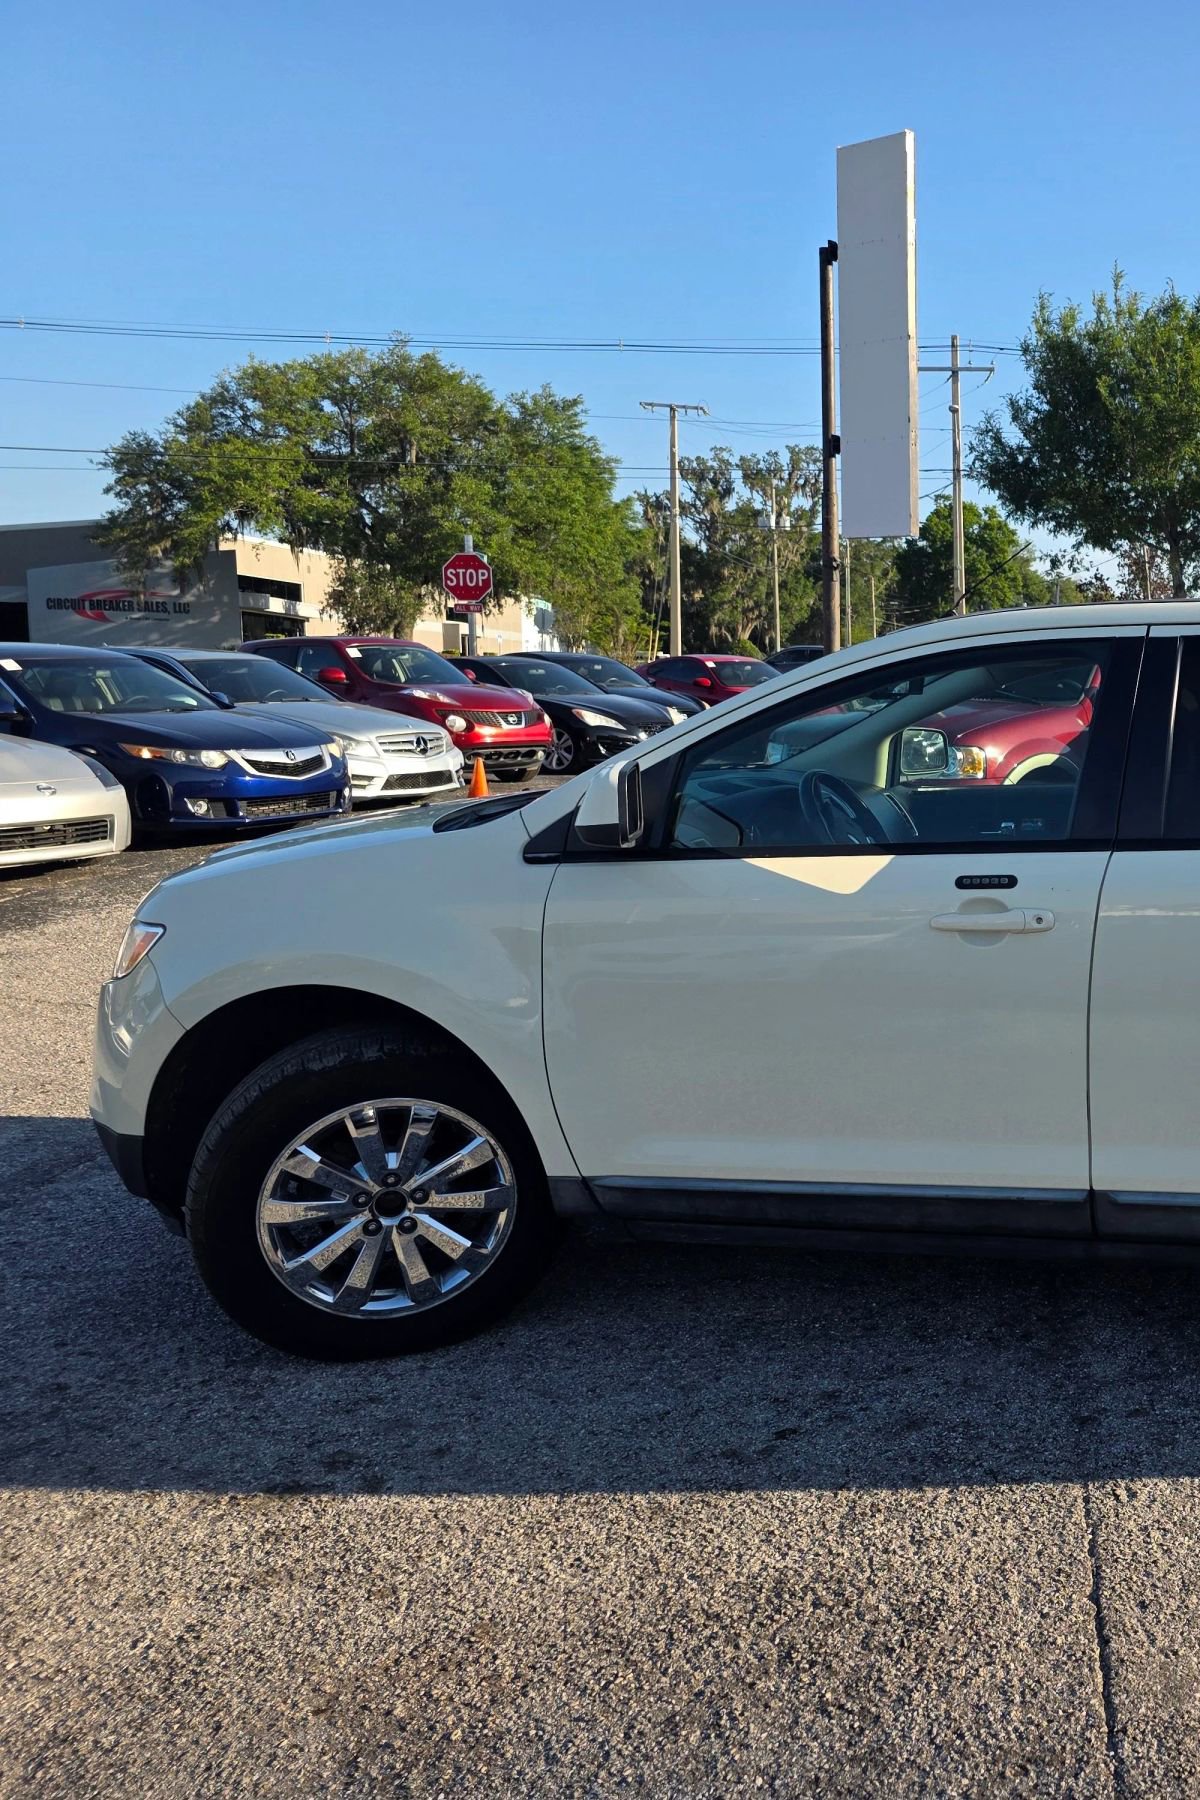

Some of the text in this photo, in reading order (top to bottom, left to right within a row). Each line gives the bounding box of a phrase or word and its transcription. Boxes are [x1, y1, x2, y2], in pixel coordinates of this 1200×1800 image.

[446, 568, 488, 587] STOP
[46, 597, 86, 611] CIRCUIT
[89, 599, 135, 612] BREAKER
[173, 601, 190, 614] LLC
